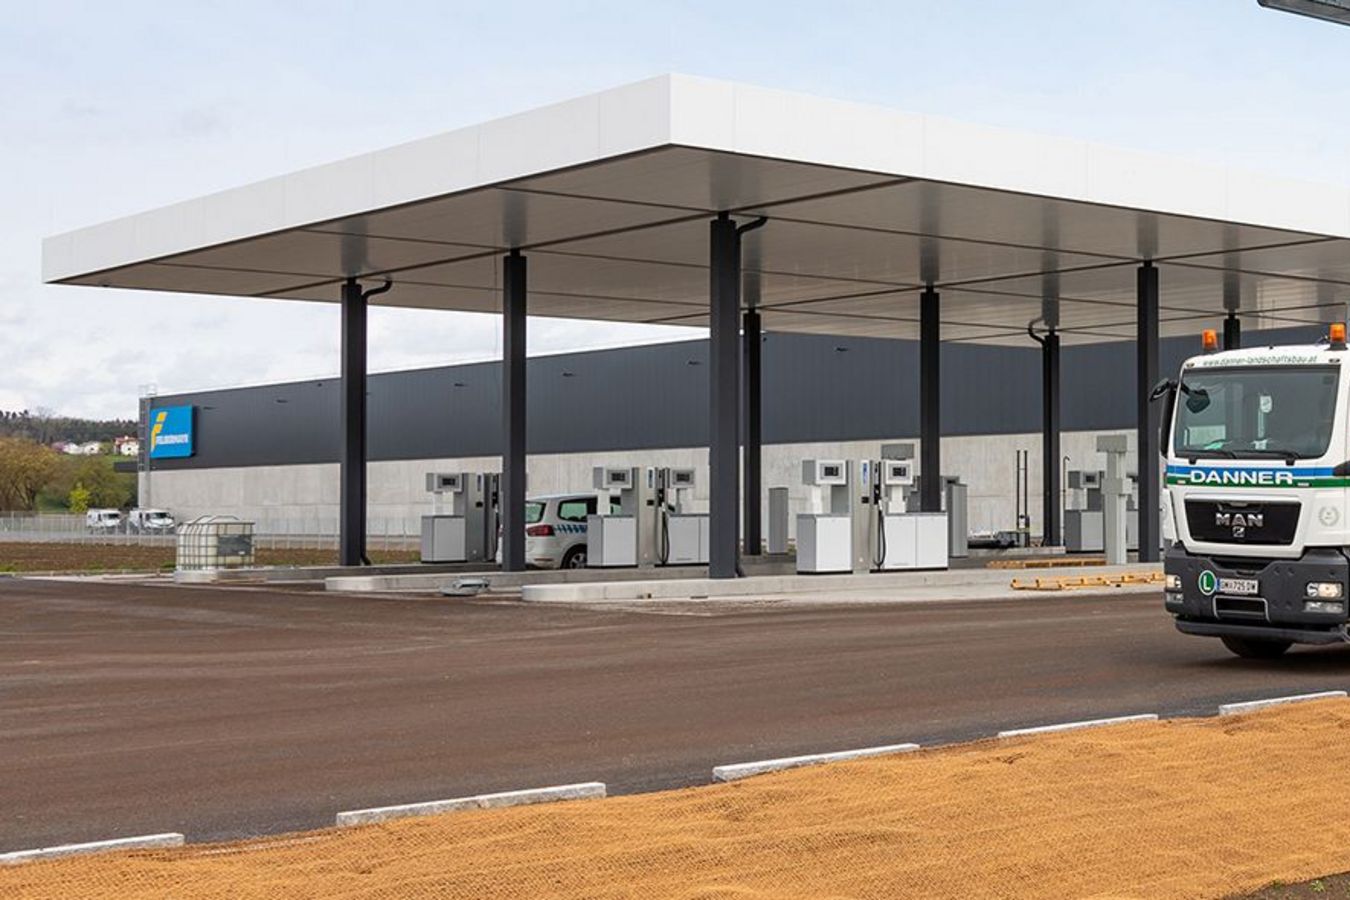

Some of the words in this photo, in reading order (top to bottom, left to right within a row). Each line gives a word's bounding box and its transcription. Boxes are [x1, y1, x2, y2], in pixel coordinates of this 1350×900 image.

[1202, 355, 1318, 366] www.danner-landschaftsbau.at
[1190, 470, 1294, 485] DANNER
[1215, 512, 1264, 528] MAN
[1203, 574, 1212, 591] L
